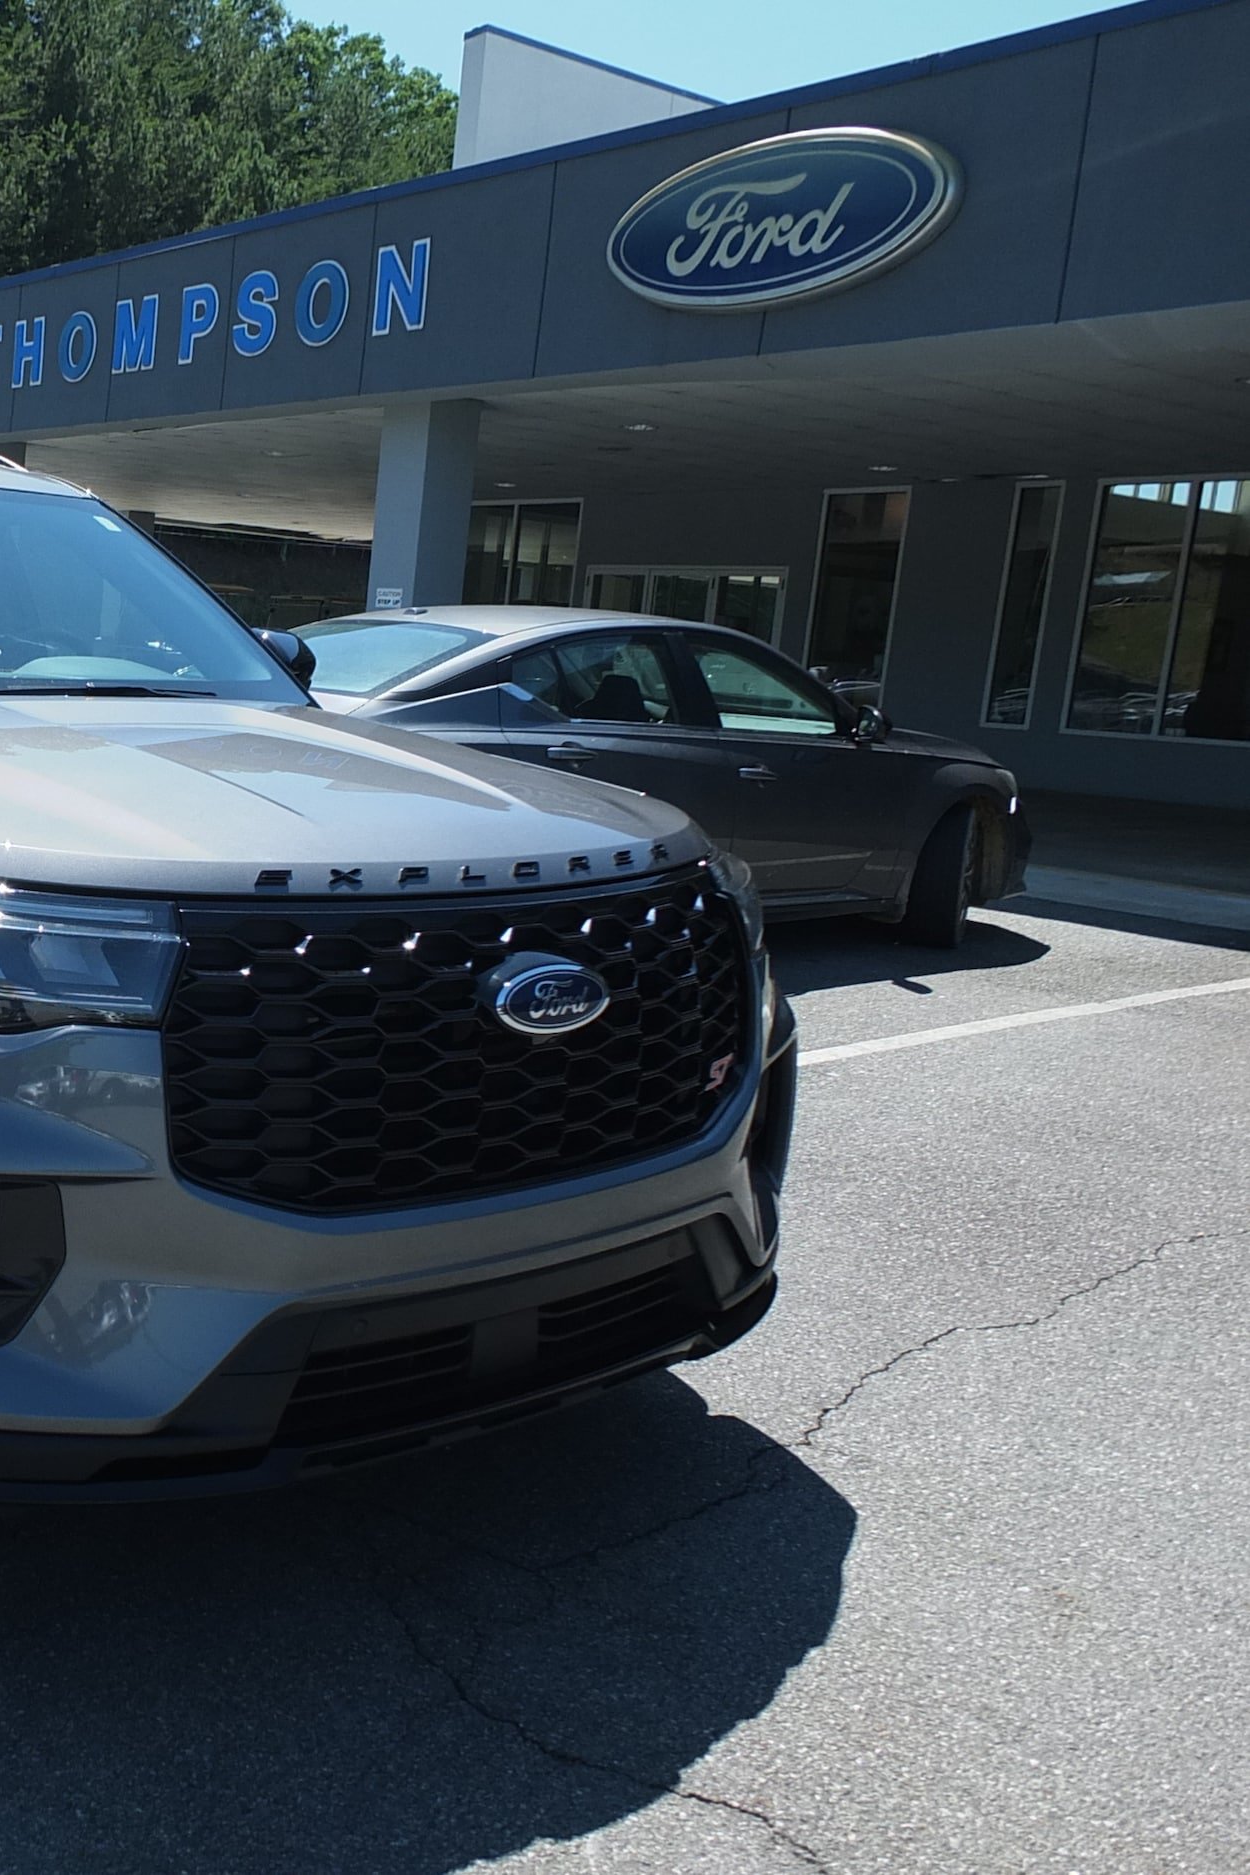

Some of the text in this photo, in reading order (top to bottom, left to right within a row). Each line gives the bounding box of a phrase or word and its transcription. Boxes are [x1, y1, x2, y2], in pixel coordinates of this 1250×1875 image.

[666, 172, 855, 277] Ford
[253, 843, 670, 887] EXPLORER
[529, 979, 590, 1019] Ford
[704, 1052, 735, 1092] ST
